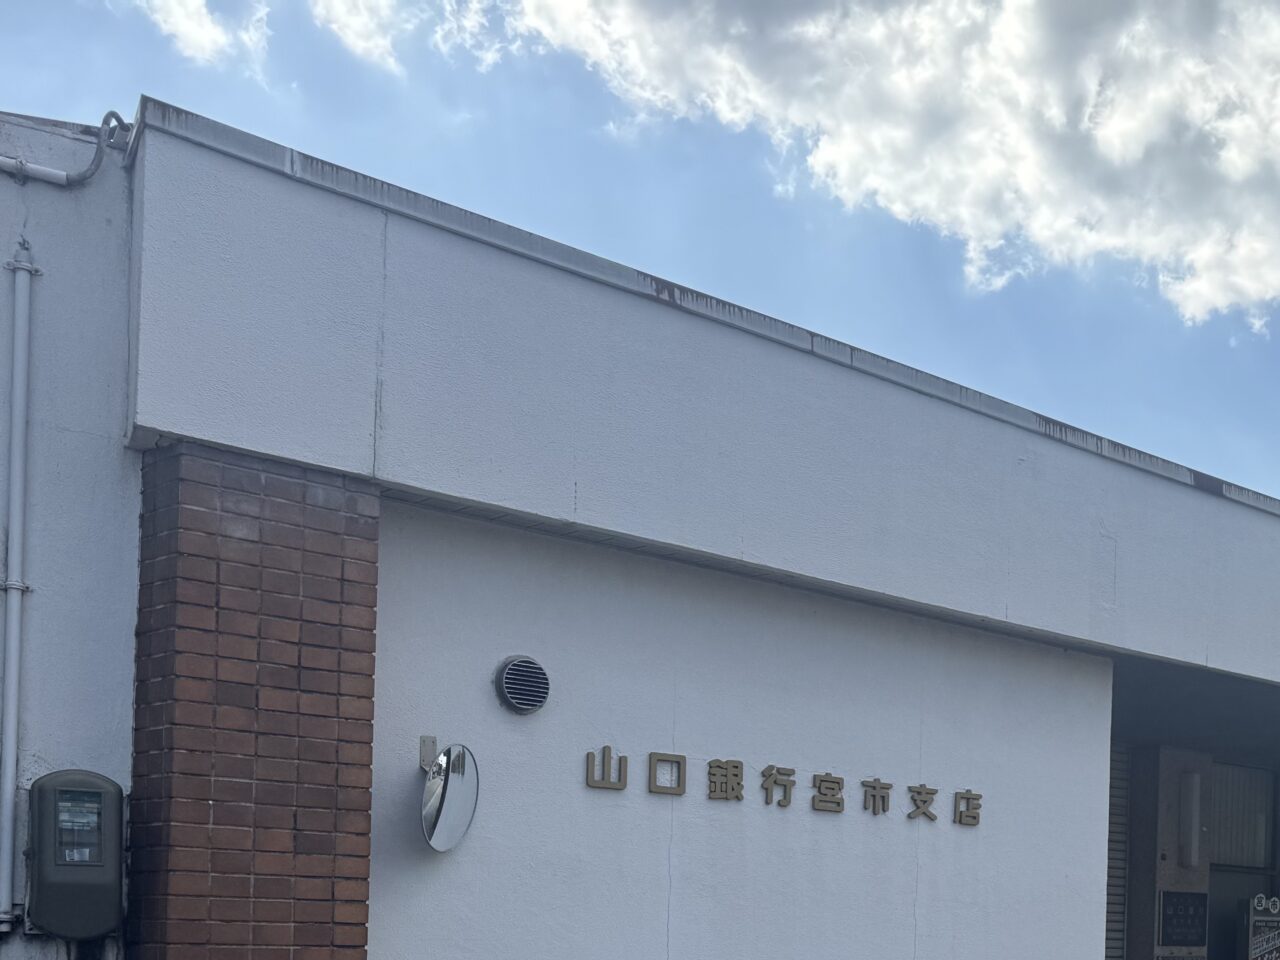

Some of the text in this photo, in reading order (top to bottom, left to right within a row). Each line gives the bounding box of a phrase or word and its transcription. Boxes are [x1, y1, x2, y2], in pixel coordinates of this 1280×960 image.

[585, 744, 983, 826] 山口銀行宮市支店
